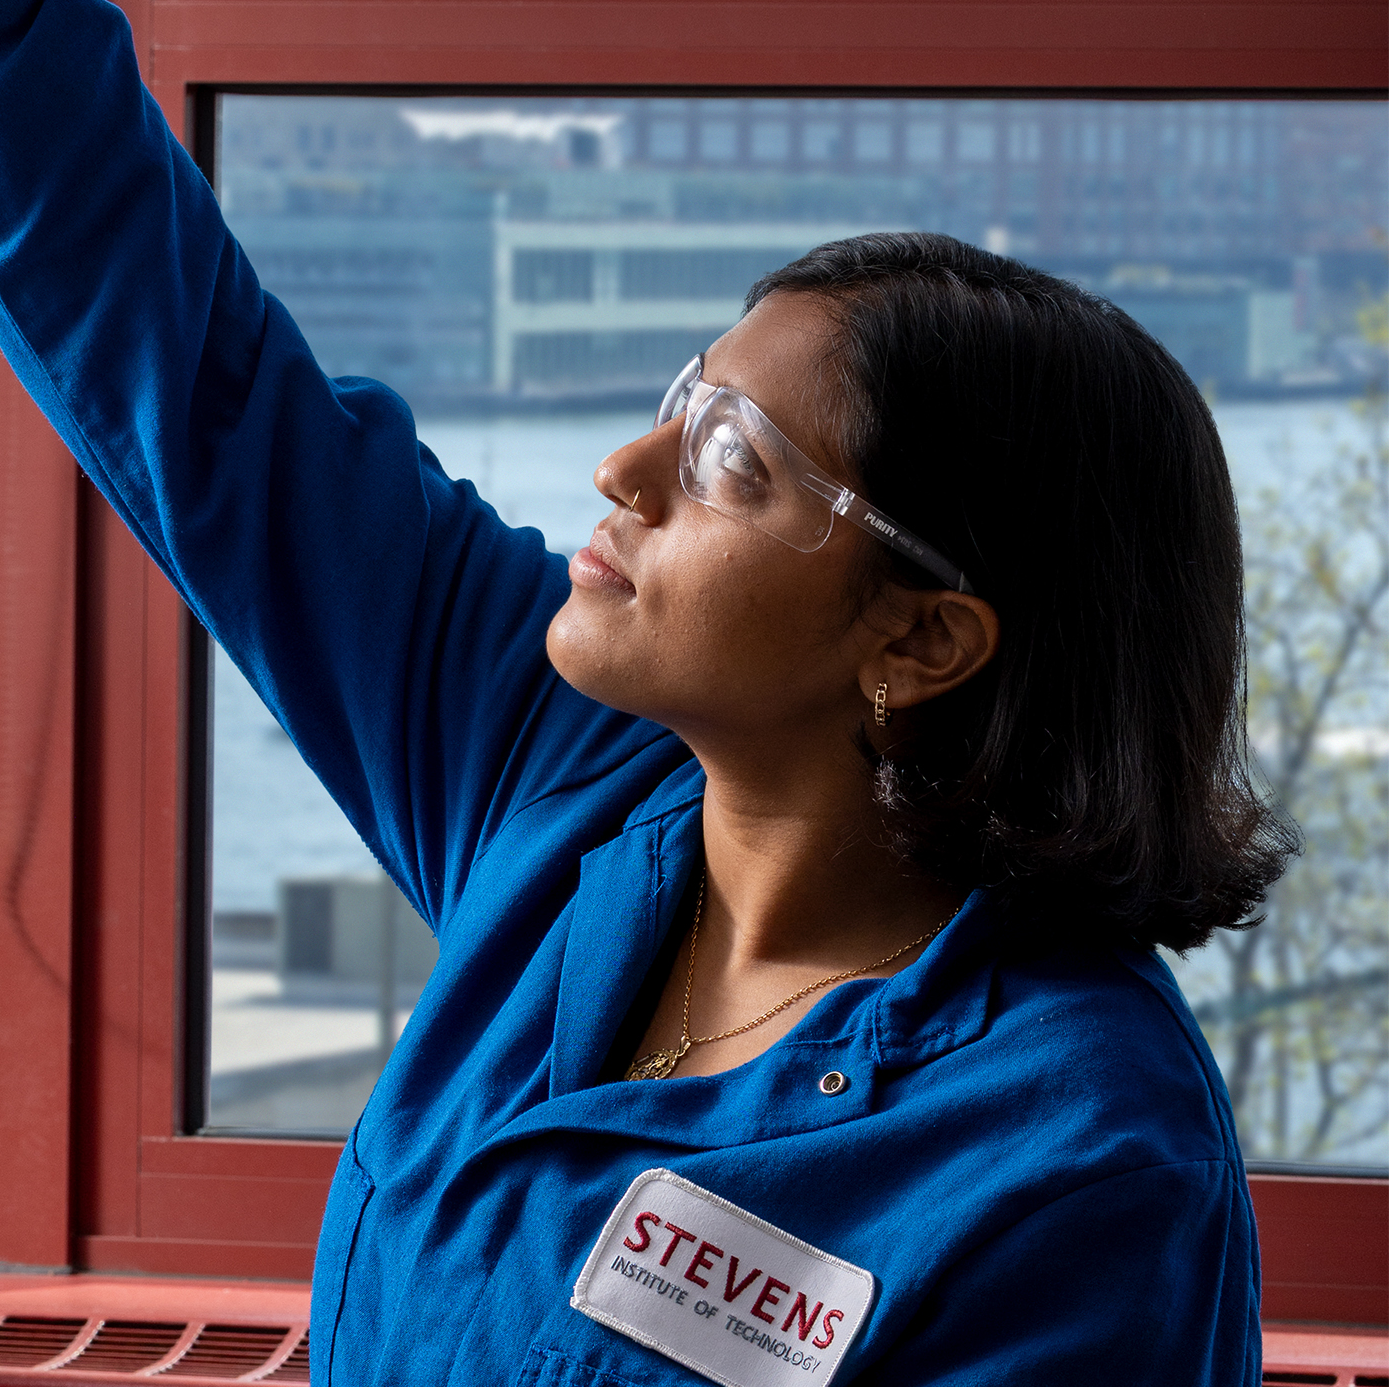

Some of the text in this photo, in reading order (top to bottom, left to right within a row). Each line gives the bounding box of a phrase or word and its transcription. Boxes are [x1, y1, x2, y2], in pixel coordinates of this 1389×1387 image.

[863, 512, 898, 538] PURITY
[610, 1254, 822, 1374] INSTITUTE OF TECHNOLOGY
[622, 1211, 845, 1350] STEVENS
